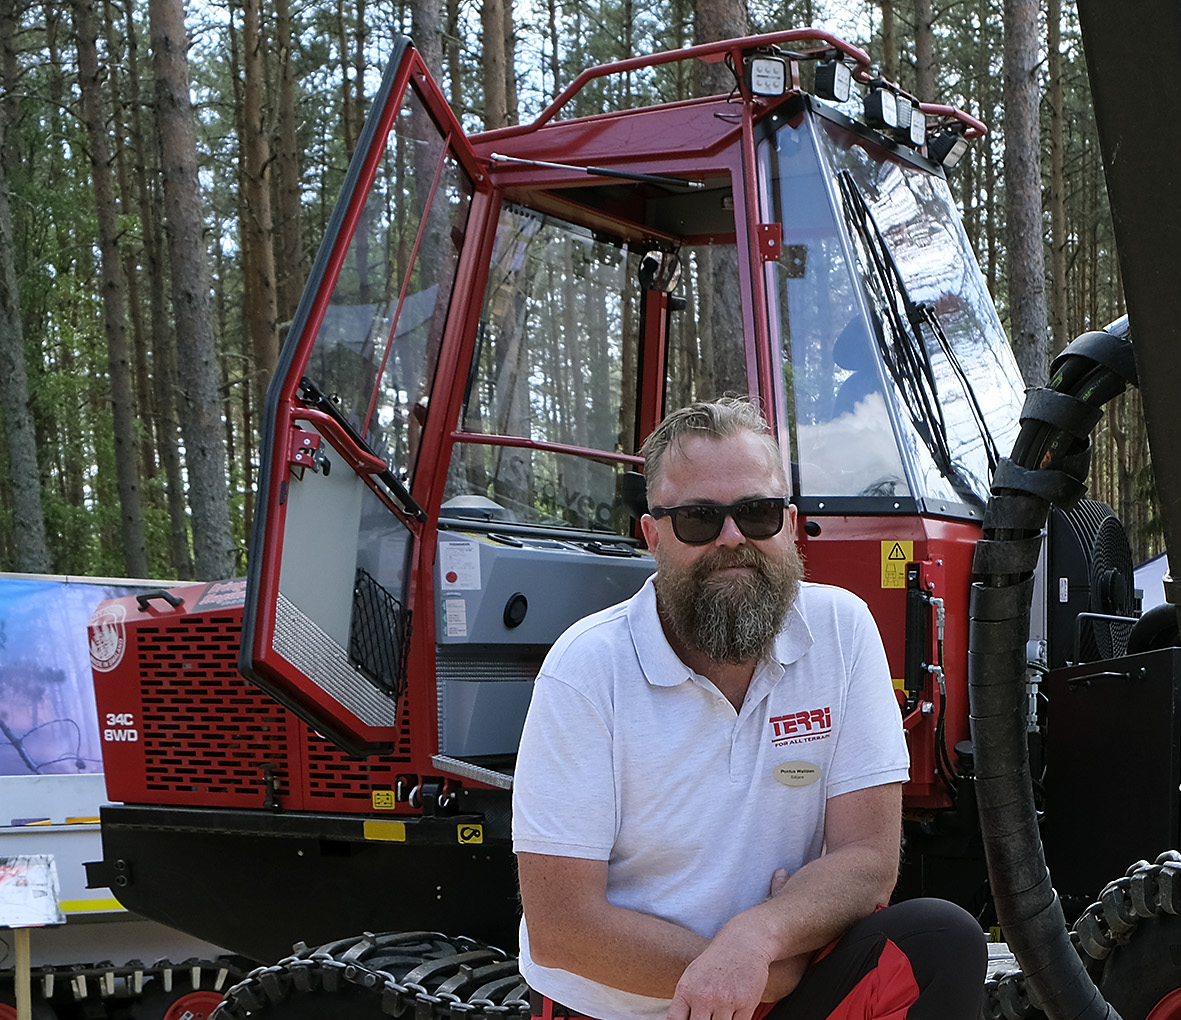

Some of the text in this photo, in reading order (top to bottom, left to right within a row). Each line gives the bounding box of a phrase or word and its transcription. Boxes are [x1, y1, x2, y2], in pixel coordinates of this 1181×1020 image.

[106, 713, 134, 726] 34C
[104, 729, 138, 742] 8WD
[775, 740, 789, 748] FOR
[803, 734, 830, 743] TERRAIN
